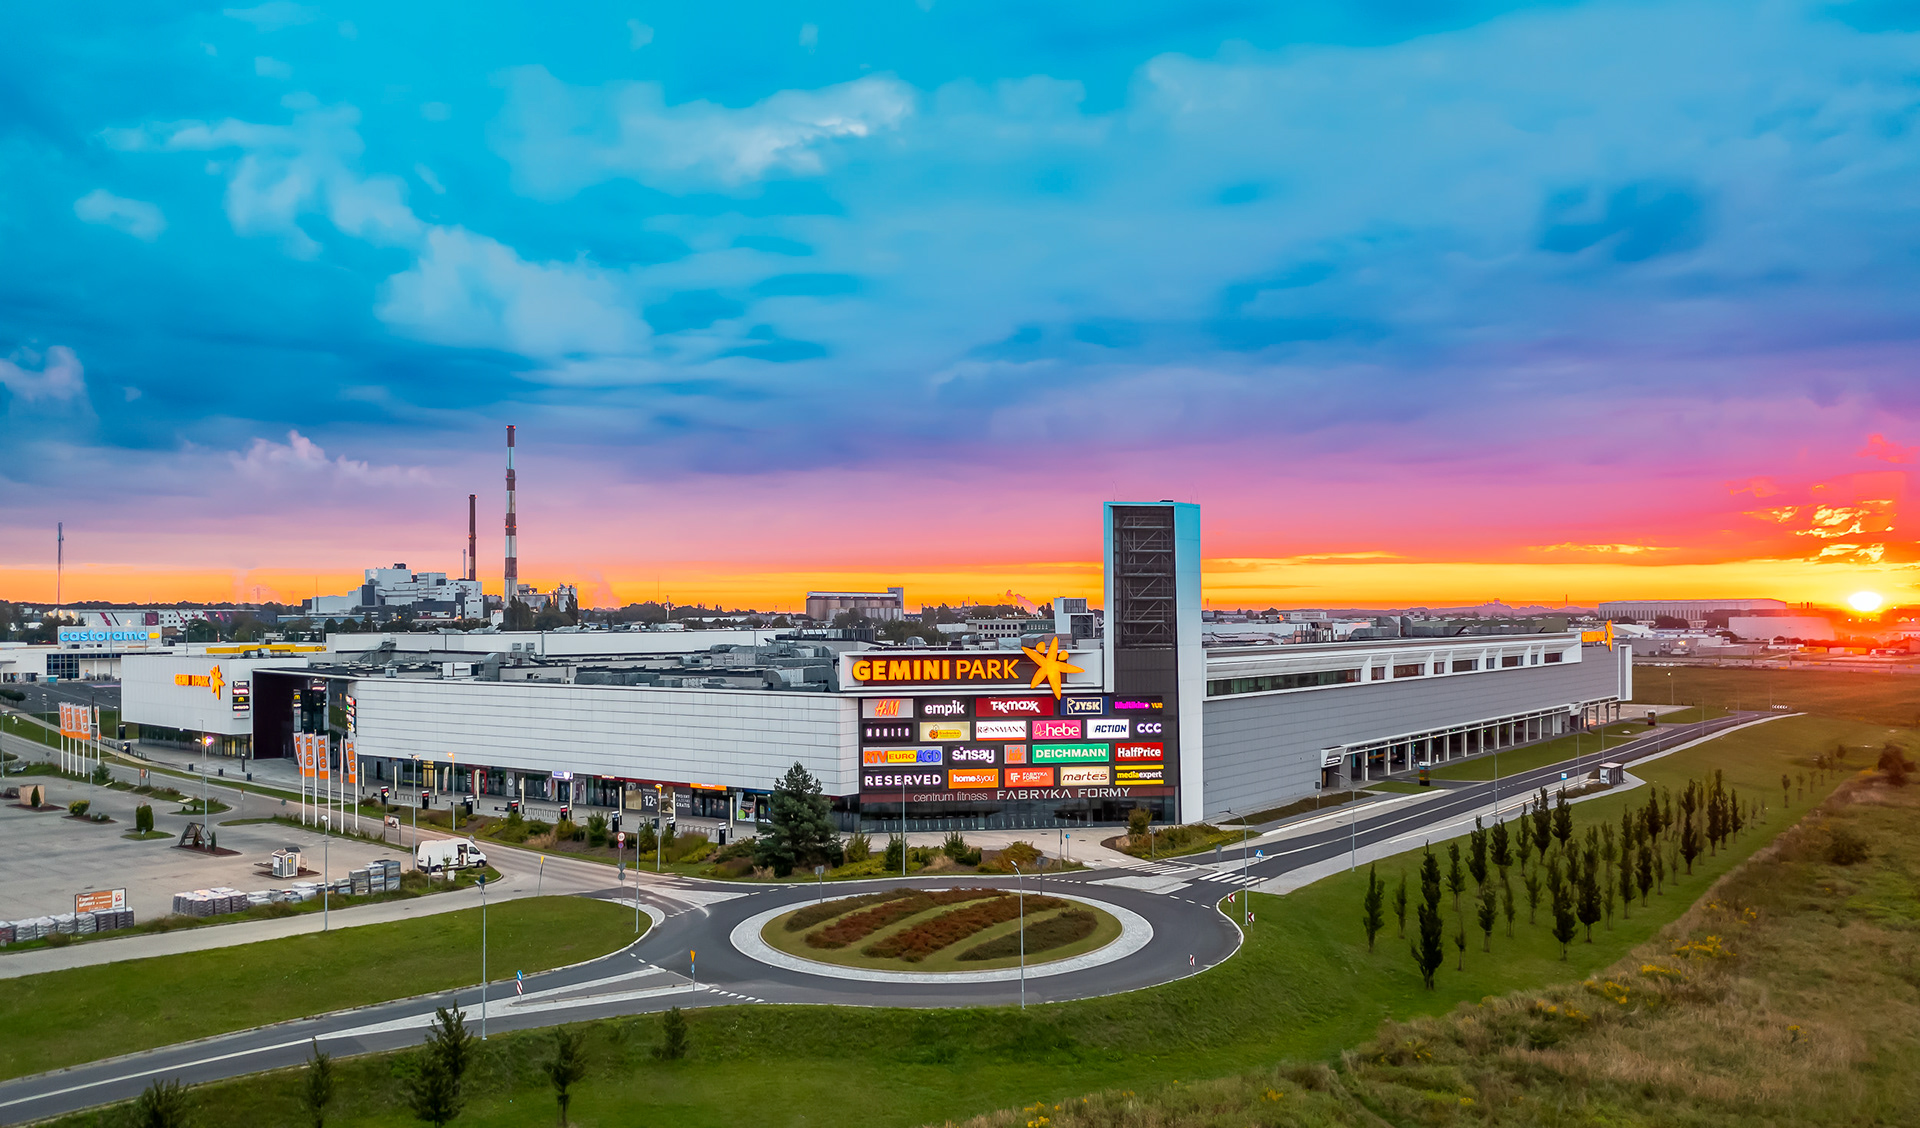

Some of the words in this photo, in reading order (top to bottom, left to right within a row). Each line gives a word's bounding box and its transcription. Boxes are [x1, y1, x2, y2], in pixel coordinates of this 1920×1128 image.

[60, 629, 148, 642] castorama
[852, 660, 950, 681] GEMINI
[956, 659, 1020, 680] PARK
[875, 700, 900, 717] H&M
[924, 699, 965, 716] empik
[1074, 701, 1101, 711] JYSK
[977, 726, 1026, 734] ROSSMANN
[1045, 723, 1079, 737] hebe
[1094, 724, 1127, 733] ACTION
[1136, 723, 1162, 734] CCC
[864, 751, 888, 763] RTV
[916, 750, 941, 763] AGD
[952, 747, 995, 763] sinsay
[1035, 749, 1107, 758] DEICHMANN
[1117, 747, 1162, 758] HalfPrice
[864, 774, 941, 786] RESERVED
[1062, 772, 1108, 781] martes
[913, 792, 954, 802] centrum
[957, 791, 988, 801] fitness
[996, 789, 1072, 800] FABRYKA
[1077, 787, 1131, 798] FORMY
